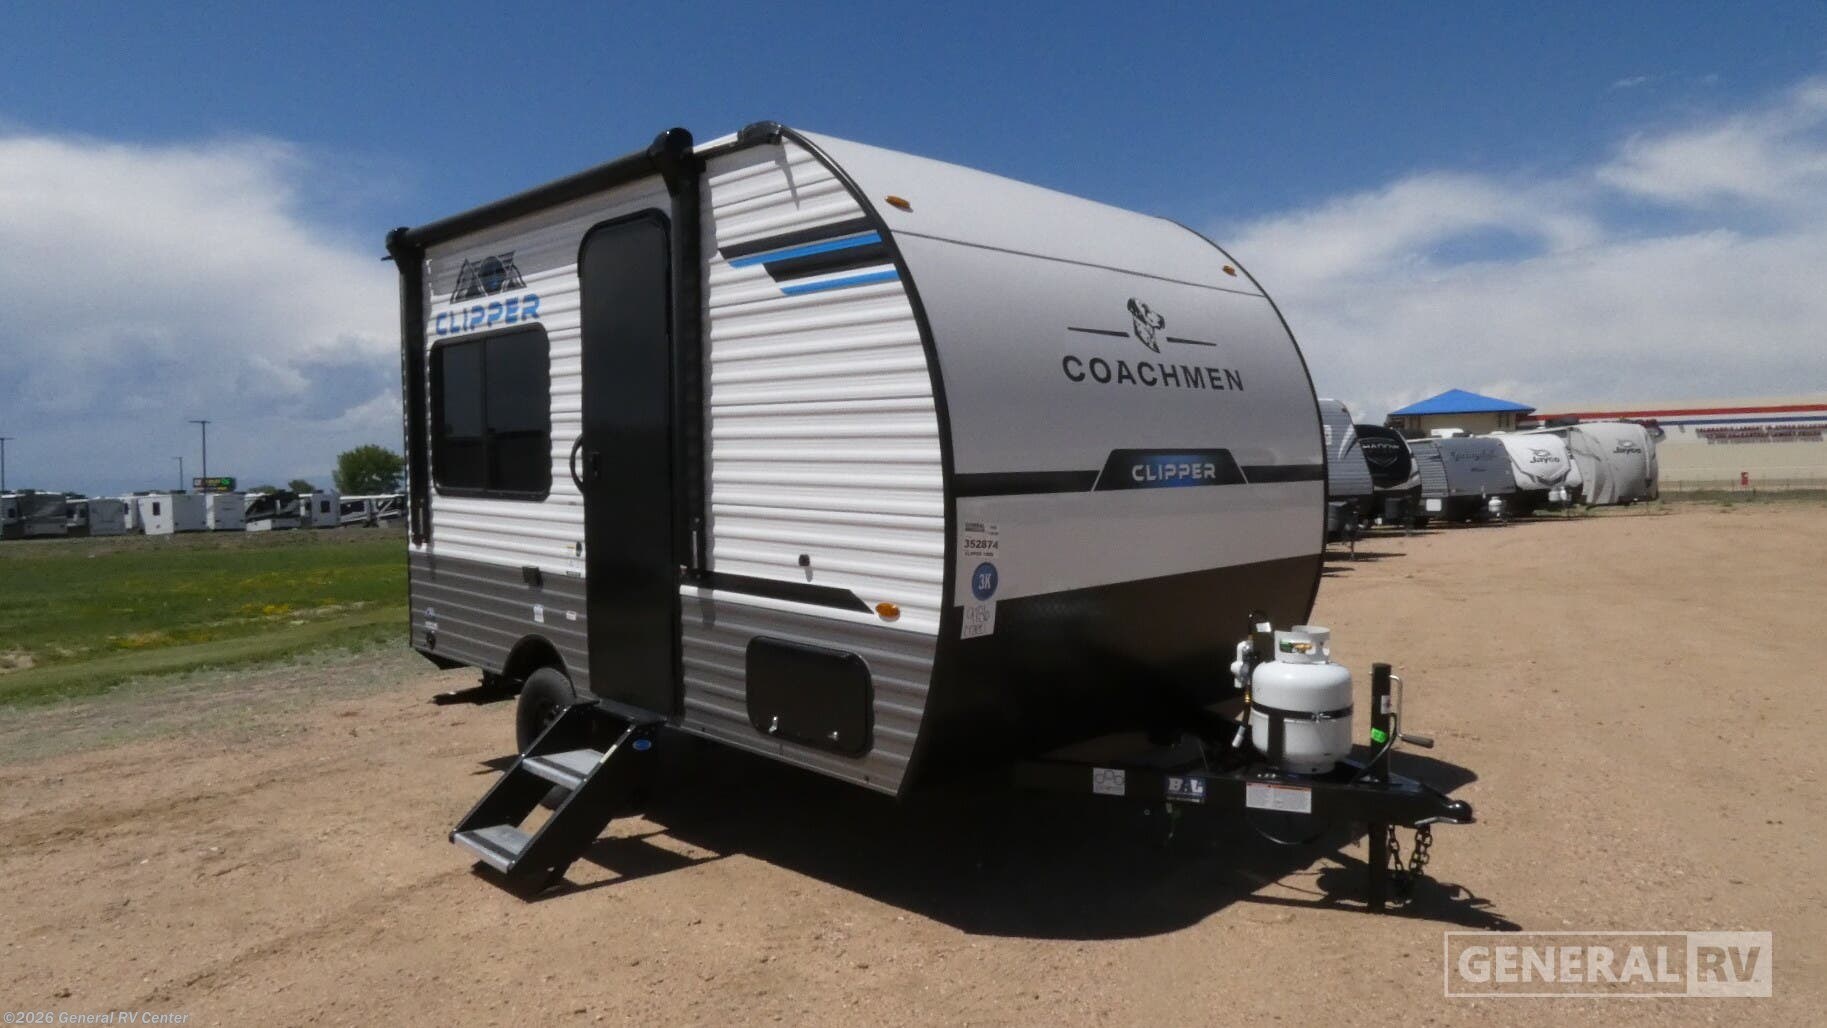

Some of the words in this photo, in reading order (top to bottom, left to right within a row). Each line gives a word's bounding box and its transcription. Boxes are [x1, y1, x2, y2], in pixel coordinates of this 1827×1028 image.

[435, 293, 541, 335] CLIPPER
[1062, 355, 1244, 391] COACHMEN
[1131, 463, 1216, 482] CLIPPER
[963, 538, 999, 550] 352874
